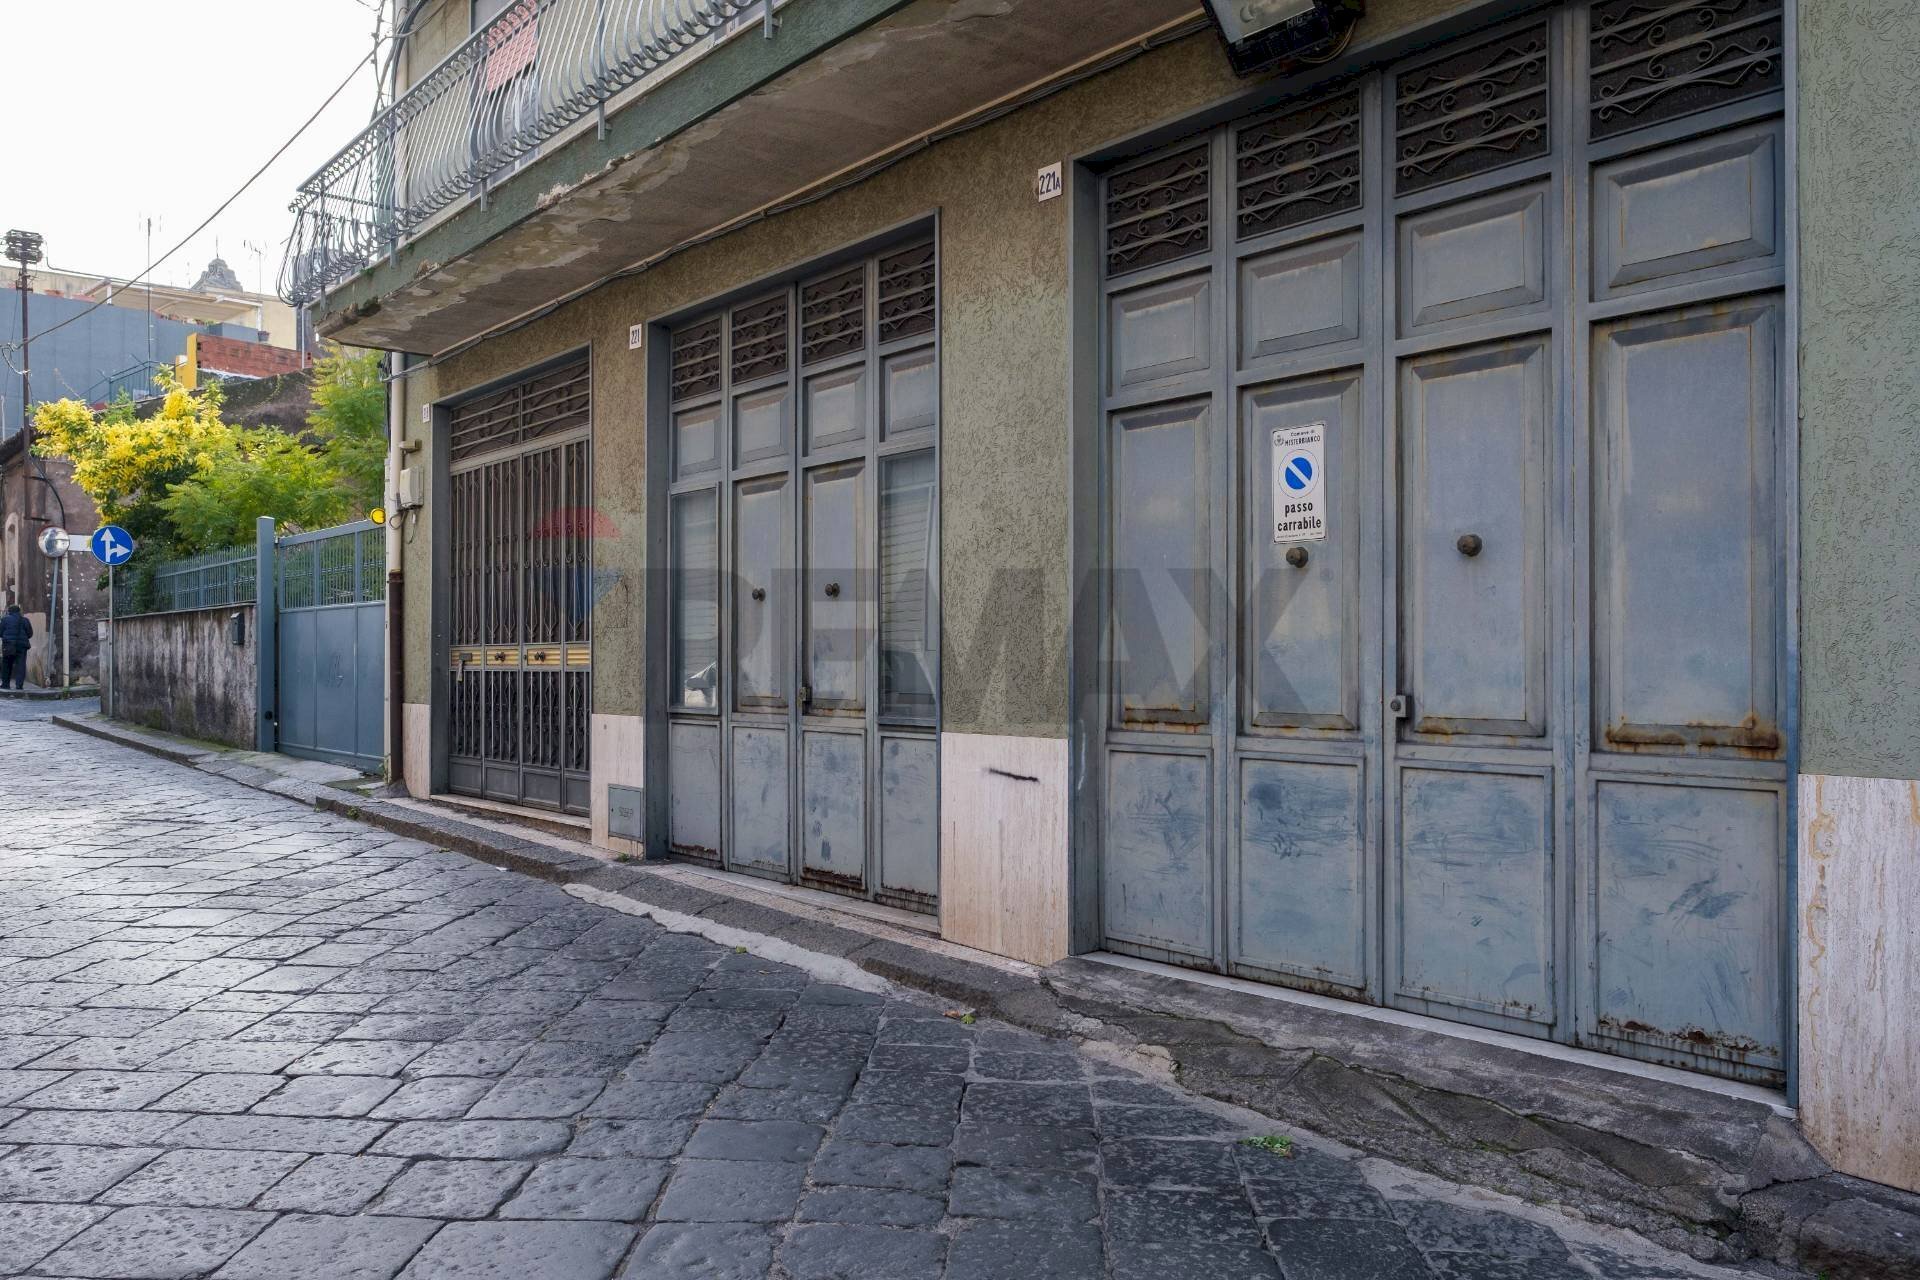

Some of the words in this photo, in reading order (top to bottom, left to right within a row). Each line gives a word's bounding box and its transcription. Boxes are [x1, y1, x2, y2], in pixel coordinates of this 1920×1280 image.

[1040, 170, 1061, 195] 221A
[631, 328, 640, 345] 221
[1285, 434, 1321, 446] MISTERBIANCO
[1284, 502, 1313, 518] passo
[1277, 515, 1322, 532] carrabile
